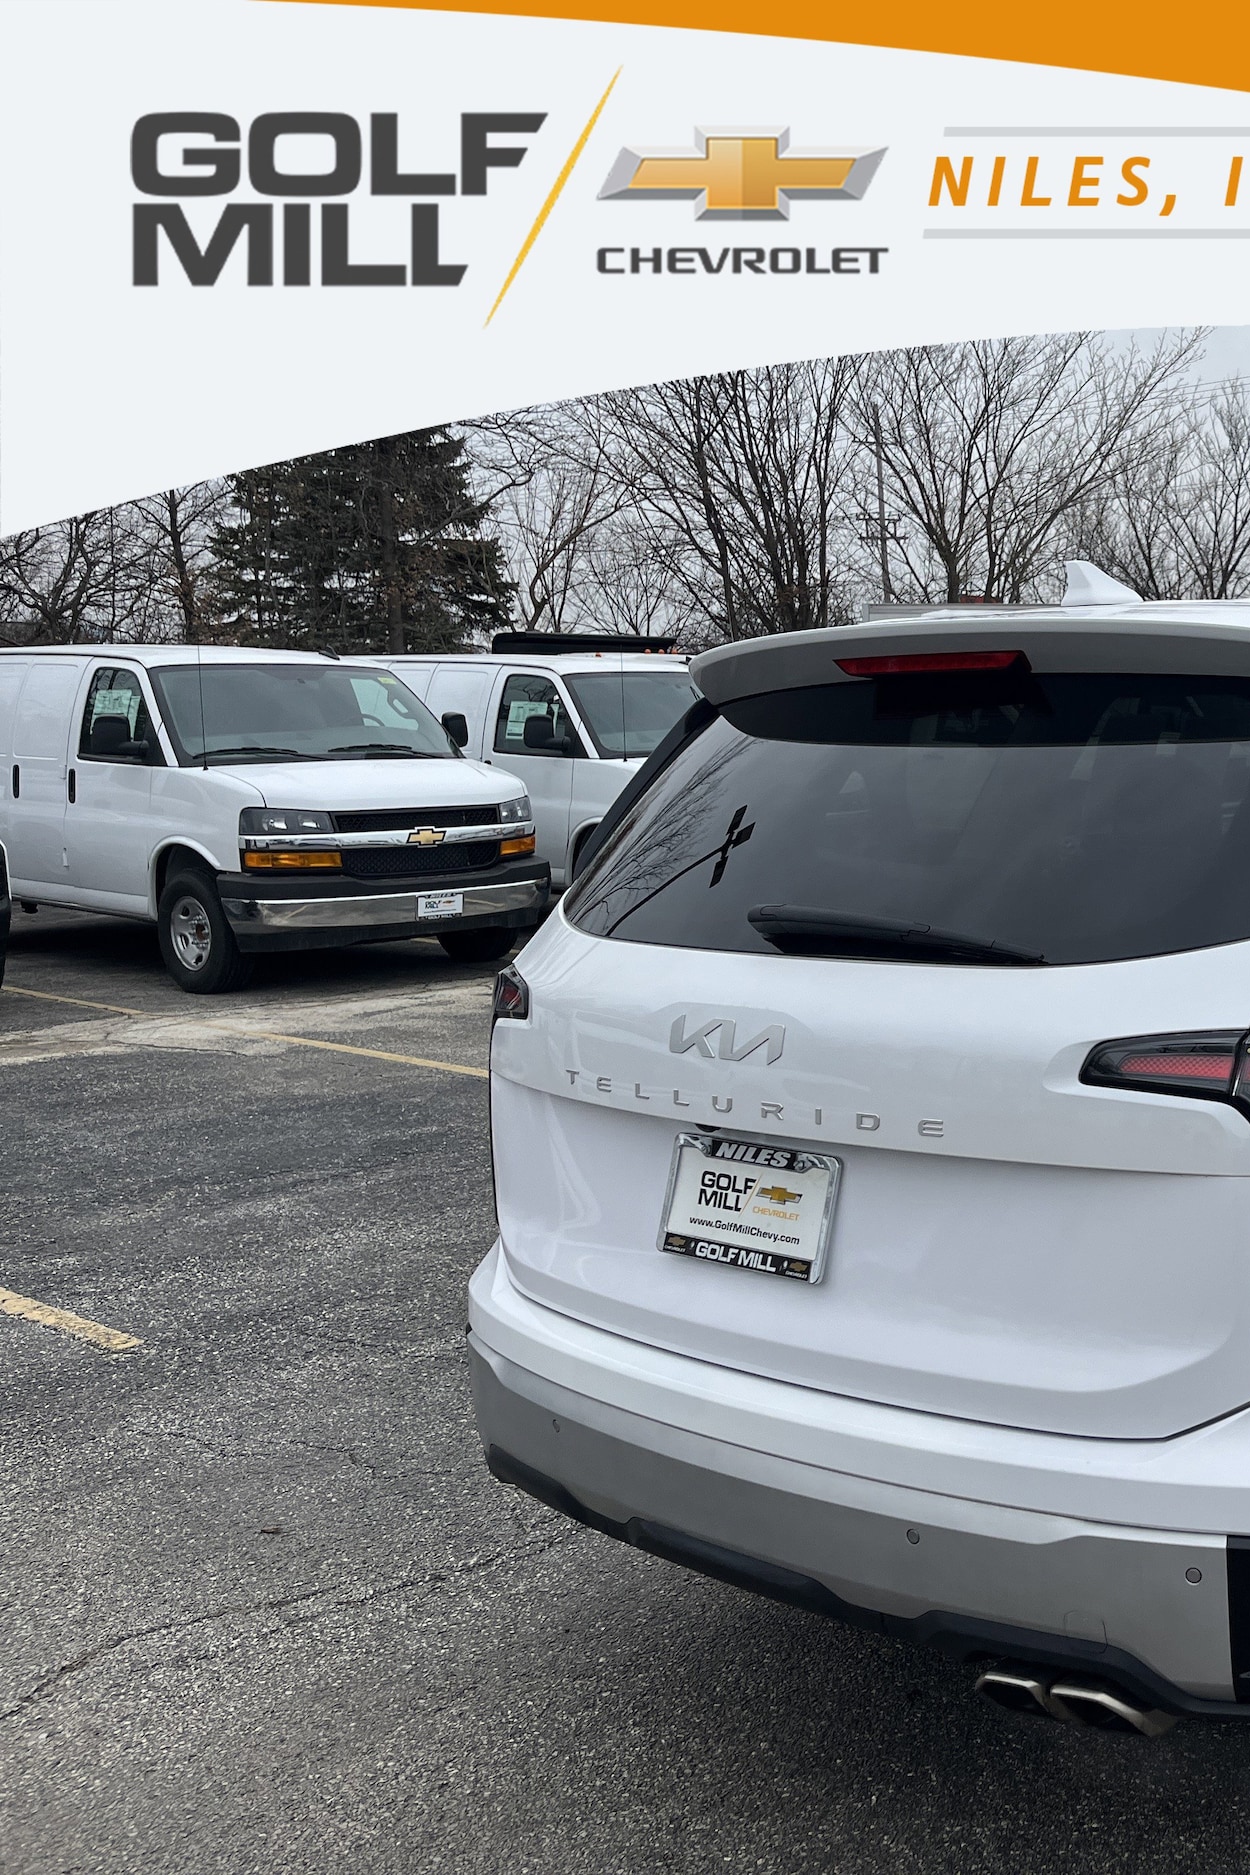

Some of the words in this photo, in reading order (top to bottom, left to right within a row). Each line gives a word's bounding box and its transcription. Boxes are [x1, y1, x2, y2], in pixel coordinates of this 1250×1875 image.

[669, 1013, 787, 1066] KIA
[565, 1068, 944, 1138] TELLURIDE
[715, 1142, 792, 1168] NILES
[701, 1170, 757, 1195] GOLF
[697, 1188, 742, 1212] MILL
[752, 1205, 801, 1222] CHEVROLET
[689, 1215, 801, 1246] www.GolfMillChevy.com
[695, 1241, 739, 1266] GOLF
[737, 1253, 777, 1273] MILL
